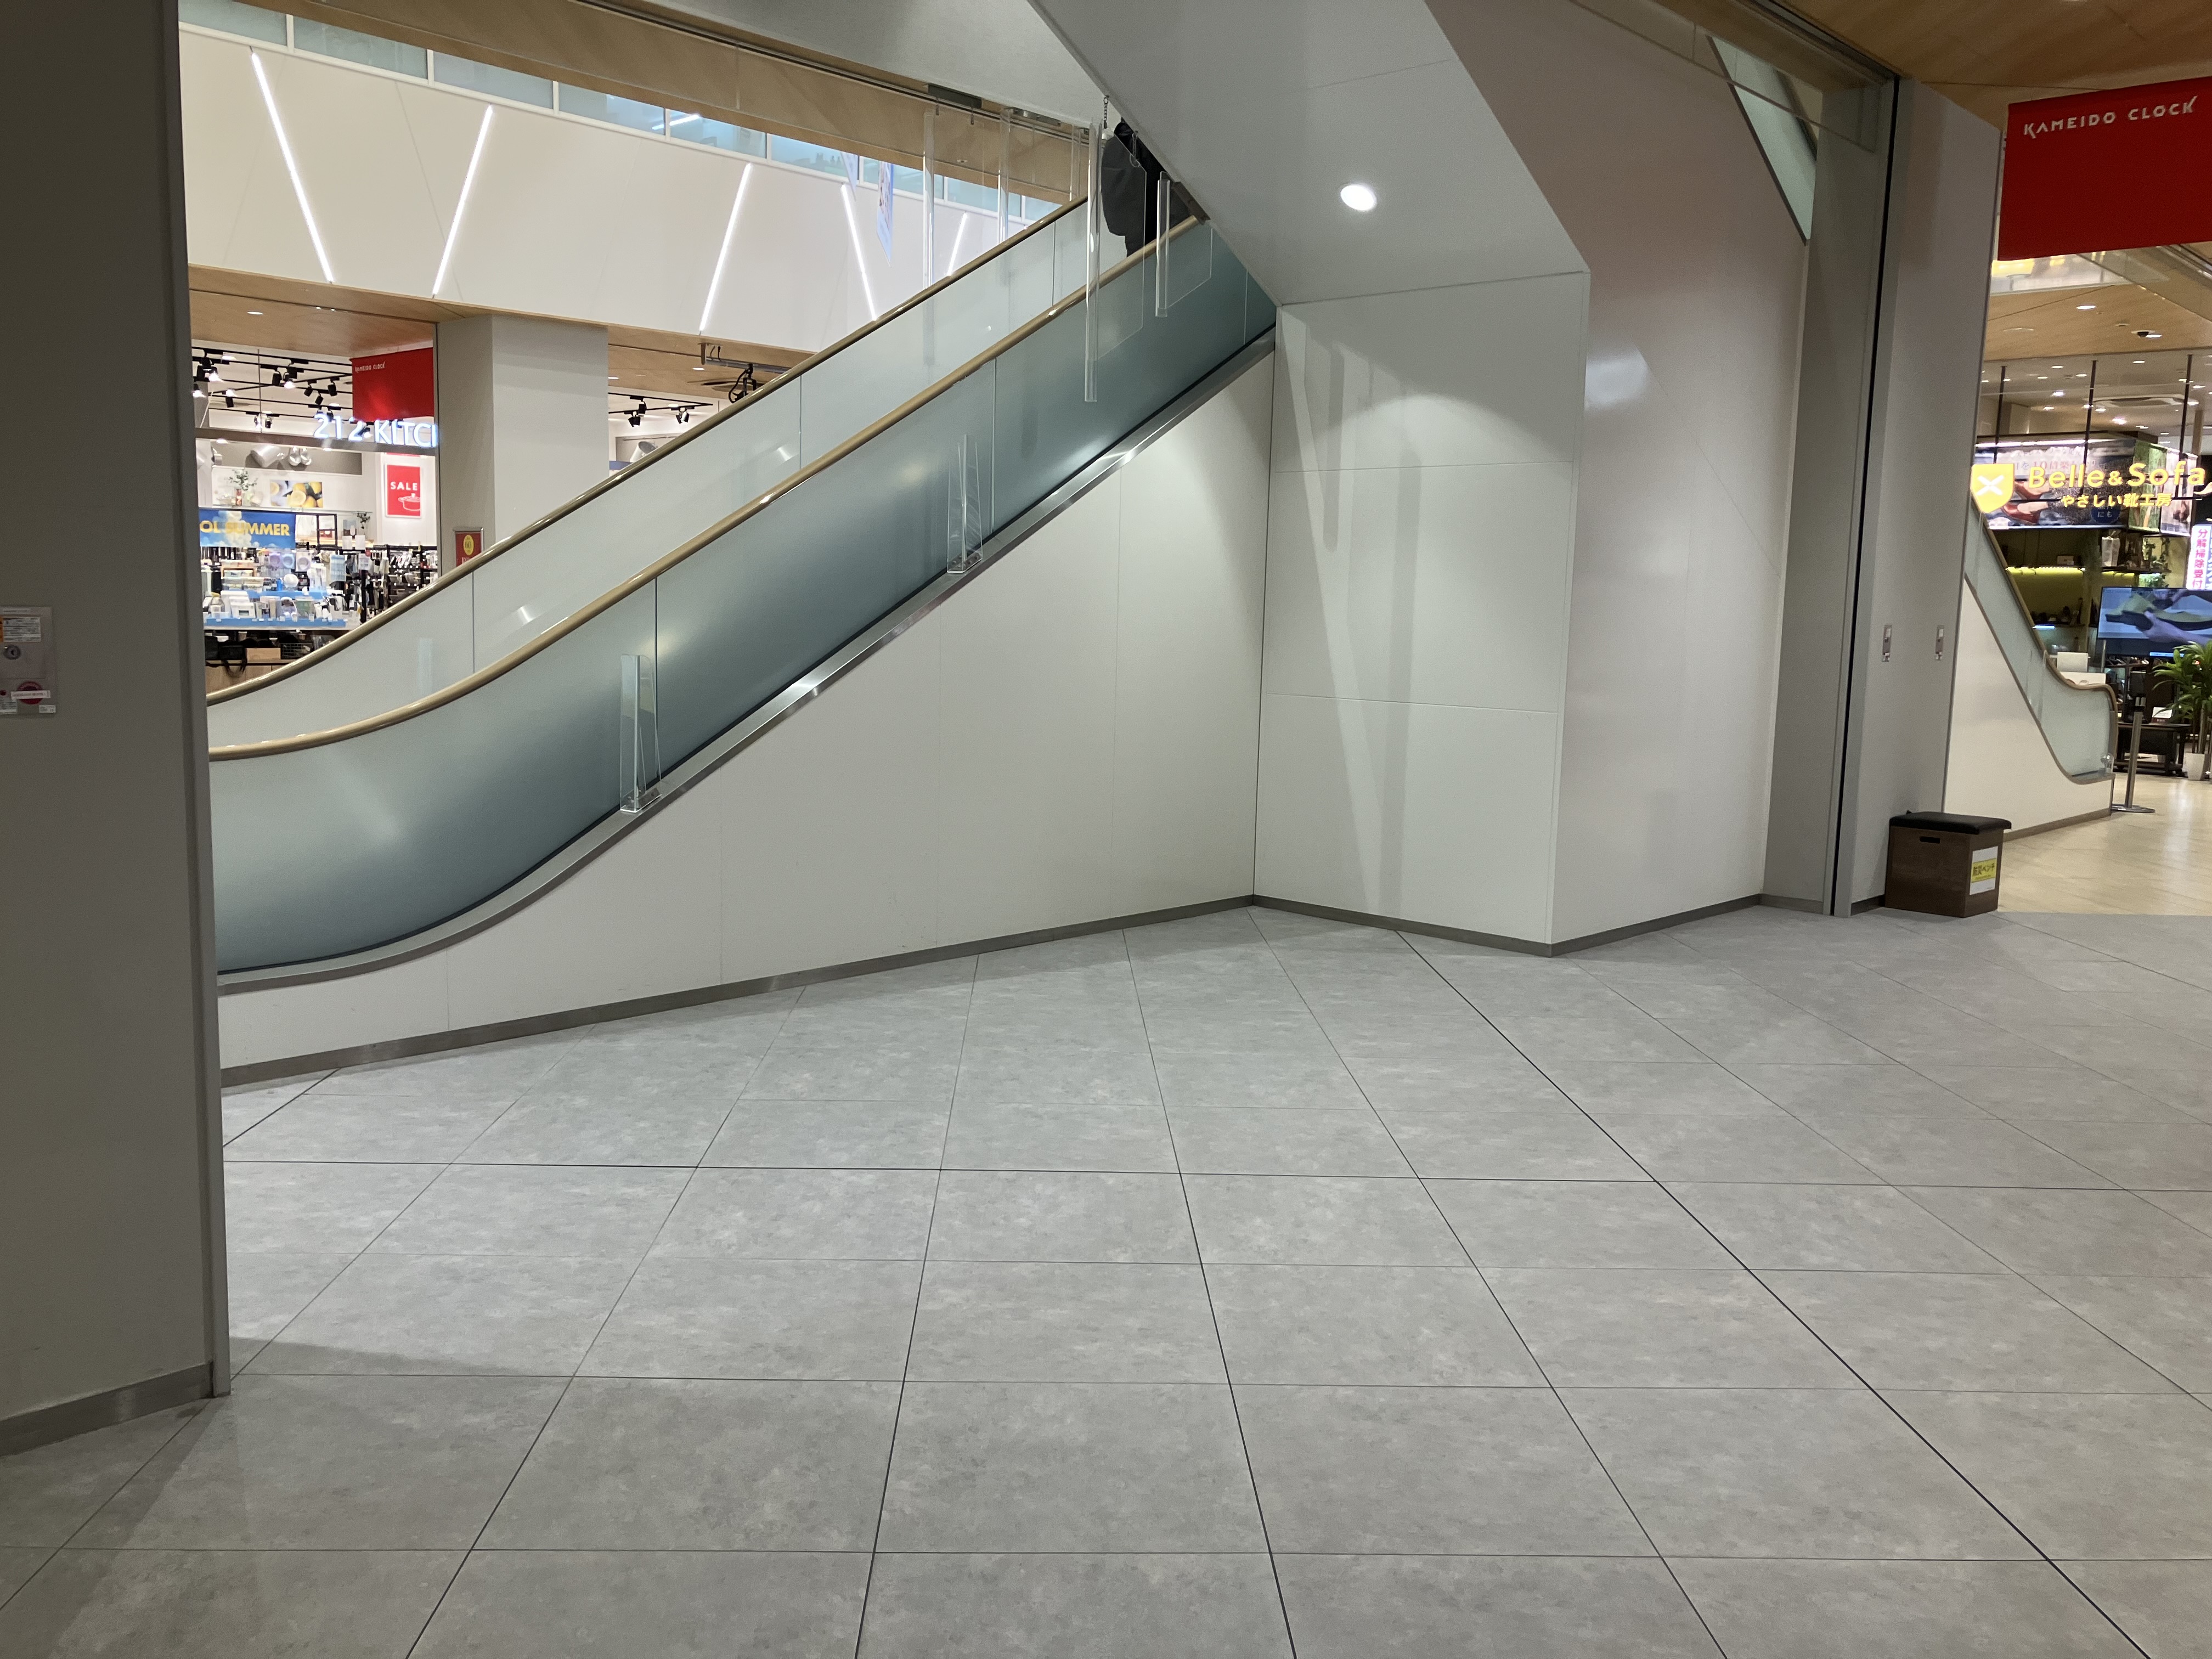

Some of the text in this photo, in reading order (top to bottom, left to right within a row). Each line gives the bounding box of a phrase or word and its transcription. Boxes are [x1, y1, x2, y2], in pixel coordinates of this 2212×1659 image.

[2024, 95, 2198, 139] KAMEIDO CLOCK
[390, 481, 418, 491] SALE
[2060, 493, 2172, 507] やさしい靴工房
[225, 522, 290, 536] SUMMER
